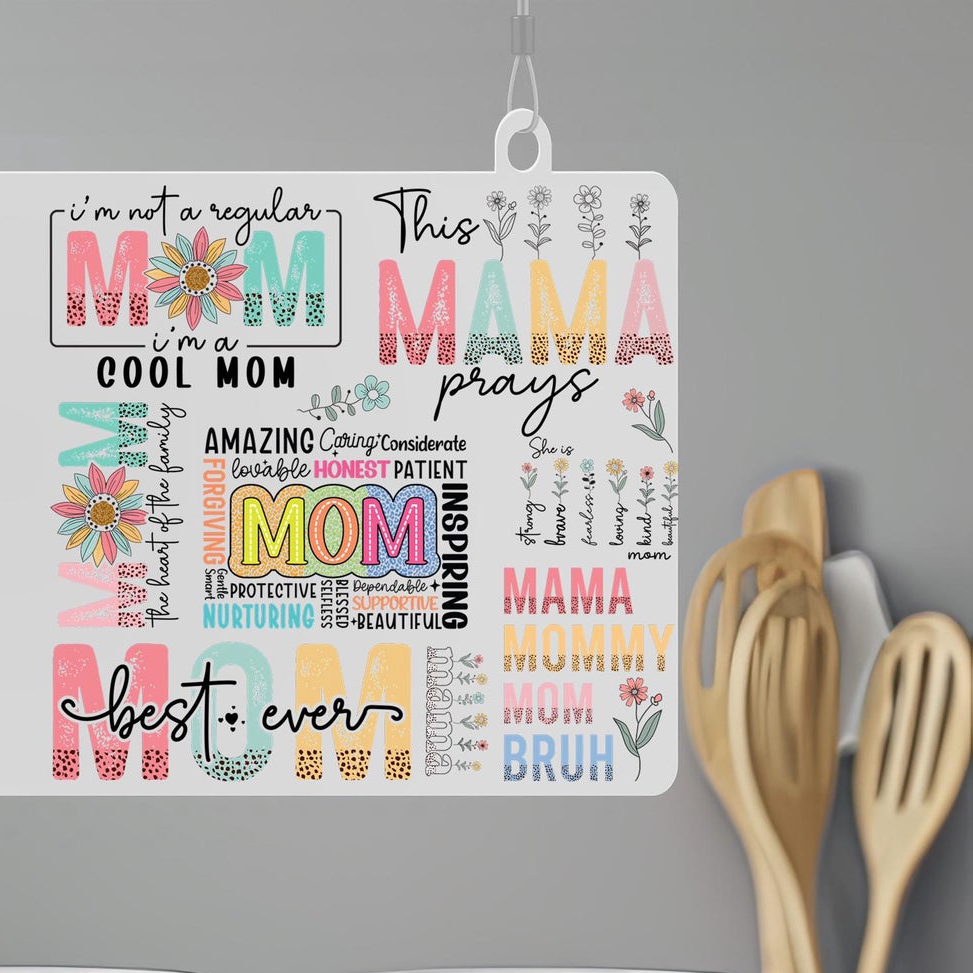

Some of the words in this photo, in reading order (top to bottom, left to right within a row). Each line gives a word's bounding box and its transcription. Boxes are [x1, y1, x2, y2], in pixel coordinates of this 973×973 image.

[70, 195, 120, 222] i'm
[128, 185, 180, 237] not
[179, 207, 203, 222] a
[209, 186, 322, 247] regular
[373, 186, 480, 254] This
[378, 258, 675, 367] MAMA
[151, 326, 206, 352] i'm
[214, 335, 240, 352] a
[96, 355, 192, 389] COOL
[216, 355, 296, 389] MOM
[431, 366, 600, 438] prays
[146, 401, 187, 474] family
[204, 427, 314, 455] AMAZING
[319, 427, 377, 457] Caring
[381, 434, 467, 452] Considerate
[529, 436, 558, 459] She
[561, 445, 575, 456] is
[231, 458, 311, 482] lovable
[313, 459, 391, 479] HONEST
[394, 459, 468, 480] PATIENT
[145, 479, 180, 514] the
[202, 458, 226, 566] FORGIVING
[146, 512, 184, 533] of
[238, 494, 431, 567] MOM
[515, 500, 547, 546] strong
[544, 503, 567, 546] brave
[579, 494, 598, 546] fearless
[609, 503, 629, 546] loving
[636, 512, 653, 546] kind
[145, 532, 180, 587] heart
[441, 482, 469, 630] INSPIRING
[628, 551, 671, 561] mom
[204, 569, 216, 600] Smart
[217, 567, 228, 600] Gentle
[230, 582, 317, 599] PROTECTIVE
[320, 579, 333, 629] SELFLESS
[335, 579, 349, 629] BLESSED
[351, 594, 439, 611] SUPPORTIVE
[352, 579, 429, 593] Dependable
[503, 567, 634, 615] MAMA
[145, 592, 180, 628] the
[202, 603, 315, 630] NURTURING
[357, 612, 442, 630] BEAUTIFUL
[503, 623, 675, 673] MOMMY
[52, 641, 413, 782] MOM
[61, 661, 237, 762] best
[262, 697, 404, 732] ever
[503, 682, 593, 725] MOM
[503, 733, 614, 782] BRUH
